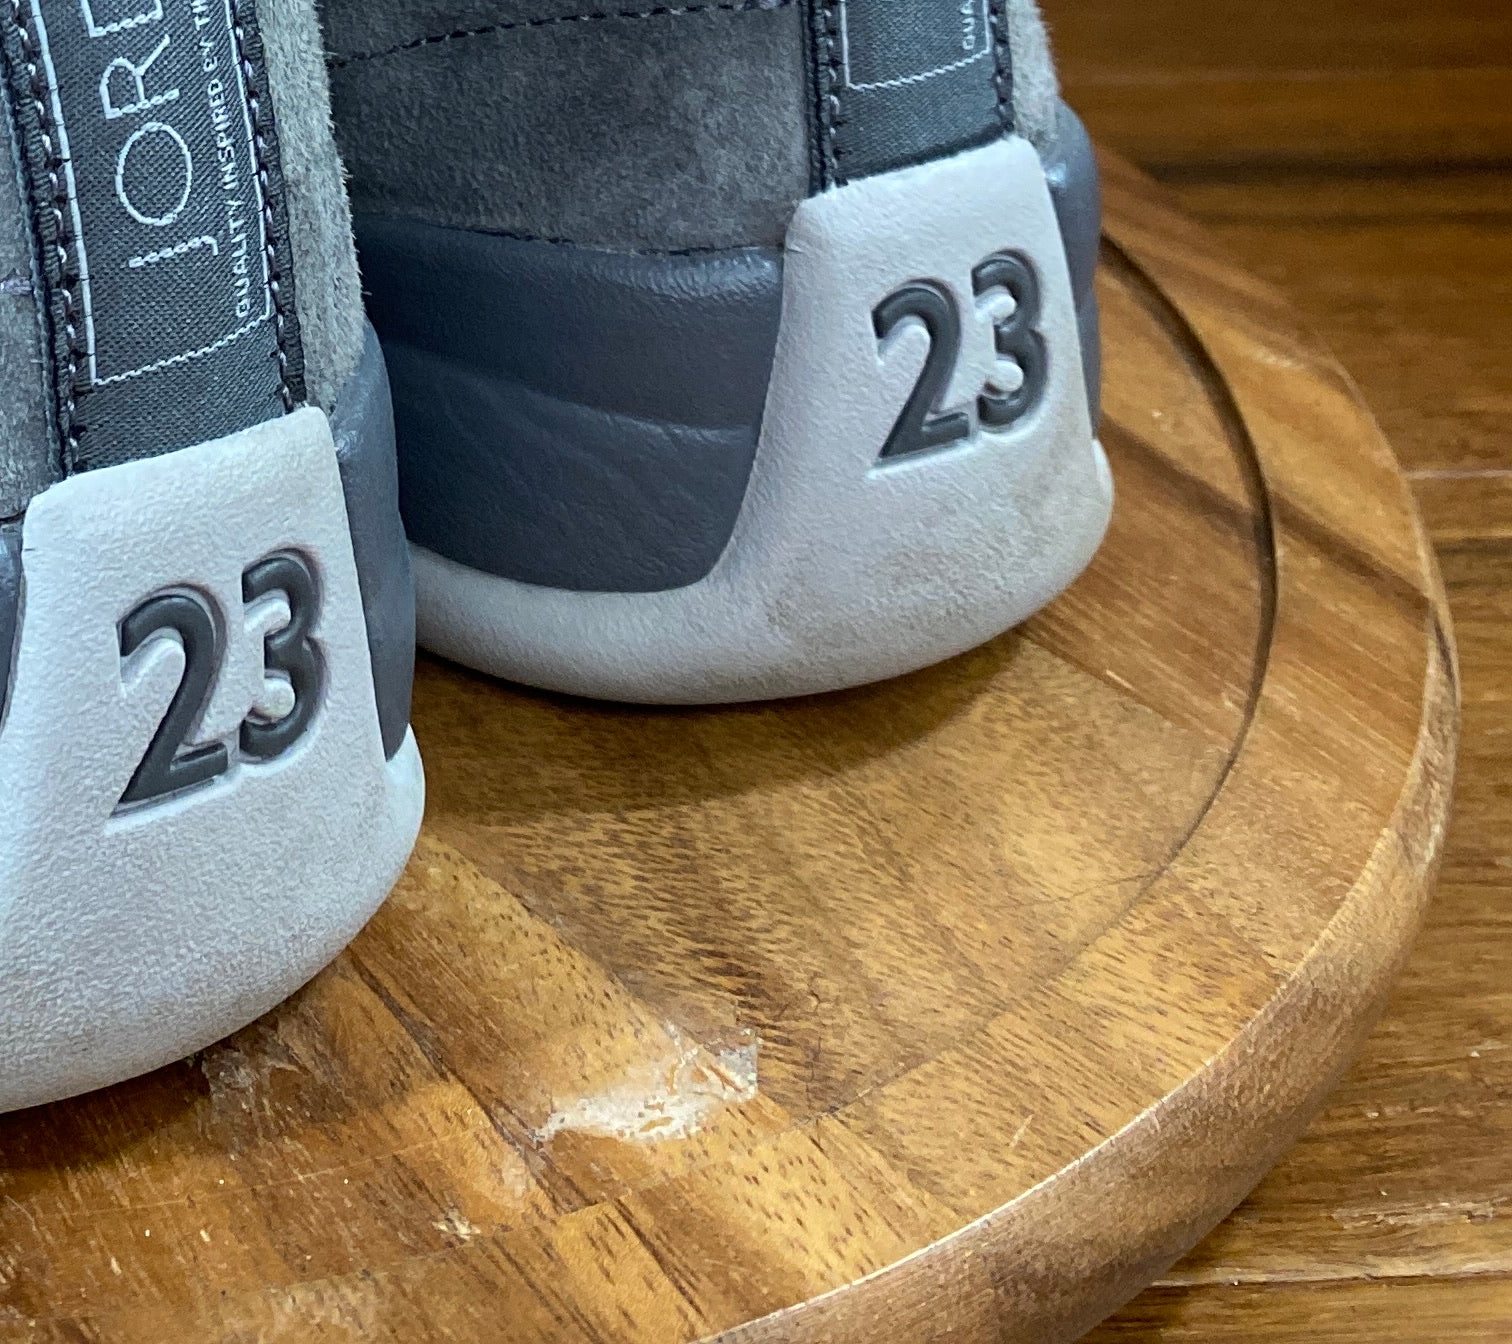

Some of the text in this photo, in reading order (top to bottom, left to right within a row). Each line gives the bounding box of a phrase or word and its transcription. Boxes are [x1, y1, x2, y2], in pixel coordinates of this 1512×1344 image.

[207, 78, 237, 191] INSPIRED
[227, 200, 251, 319] QUALITY
[871, 248, 1049, 464] 23
[110, 546, 331, 817] 23
